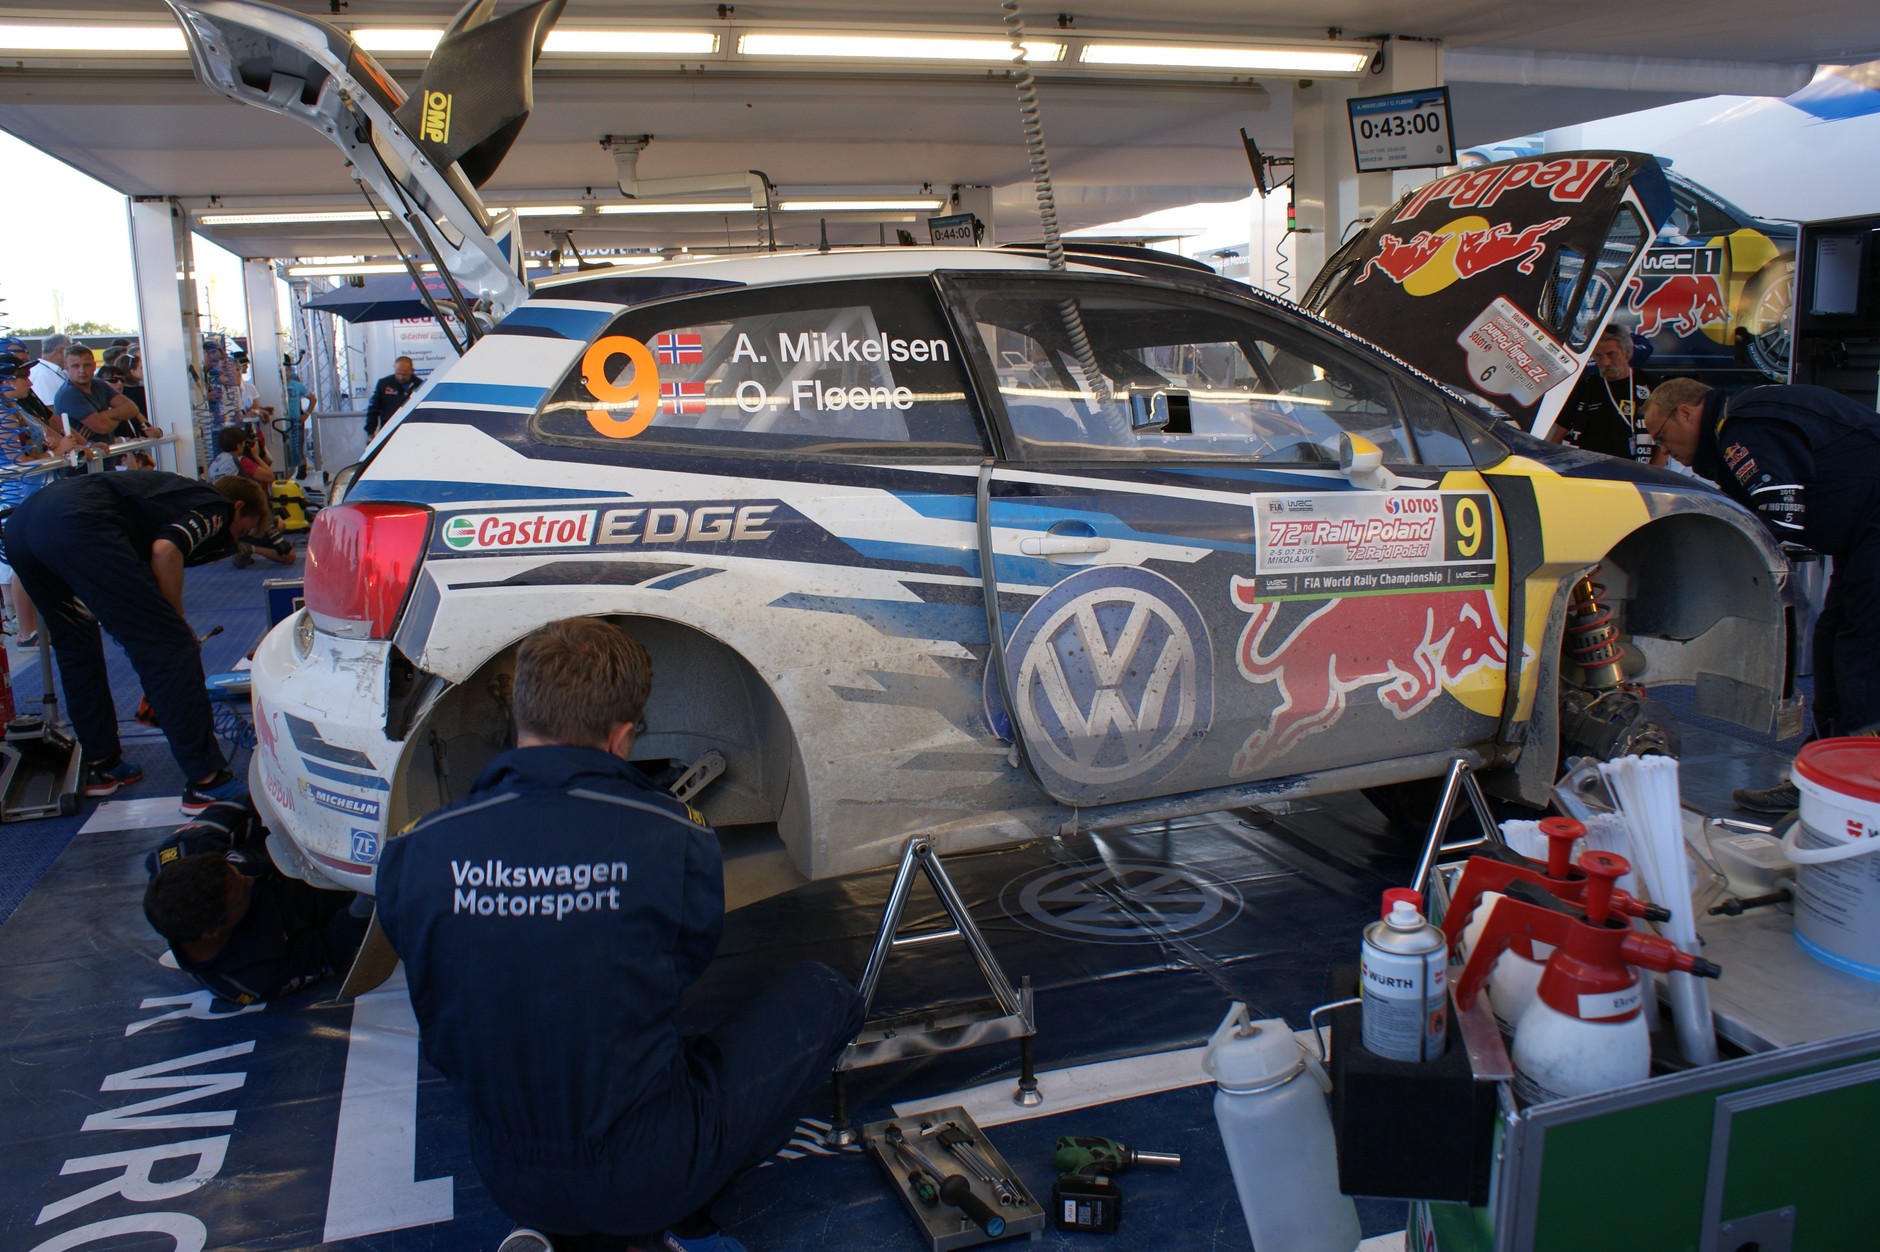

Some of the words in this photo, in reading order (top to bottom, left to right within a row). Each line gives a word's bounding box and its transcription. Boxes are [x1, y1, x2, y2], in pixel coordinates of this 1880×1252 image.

[425, 91, 448, 143] OMP
[1360, 111, 1440, 140] 0:43:00
[934, 226, 971, 241] 0:44:00
[1642, 253, 1693, 270] WRC
[1704, 250, 1713, 273] 1
[732, 333, 767, 363] A.
[780, 332, 949, 363] Mikkelsen
[1251, 286, 1467, 405] www.volkswagen-motorsport.com
[1469, 331, 1487, 350] LOTOS
[1479, 321, 1509, 351] Poland
[1507, 343, 1534, 370] Rally
[582, 335, 659, 438] 9
[735, 380, 777, 412] O.
[791, 379, 914, 412] Fløene
[1269, 503, 1284, 512] FIA
[1287, 499, 1313, 508] WRC
[1401, 498, 1439, 514] LOTOS
[478, 513, 588, 548] Castrol
[596, 505, 781, 546] EDGE
[1312, 520, 1366, 548] Rally
[1365, 517, 1435, 544] Poland
[1455, 497, 1482, 557] 9
[1267, 555, 1314, 565] MIKOŁAJKI
[1347, 547, 1365, 562] 72
[1365, 545, 1393, 562] Rajd
[1392, 543, 1430, 560] Polski
[1304, 577, 1321, 589] FIA
[1323, 576, 1351, 588] World
[1353, 574, 1378, 588] Rally
[1379, 571, 1443, 587] Championship
[315, 790, 378, 815] MICHELIN
[355, 836, 374, 855] ZF
[451, 859, 628, 891] Volkswagen
[453, 886, 621, 921] Motorsport
